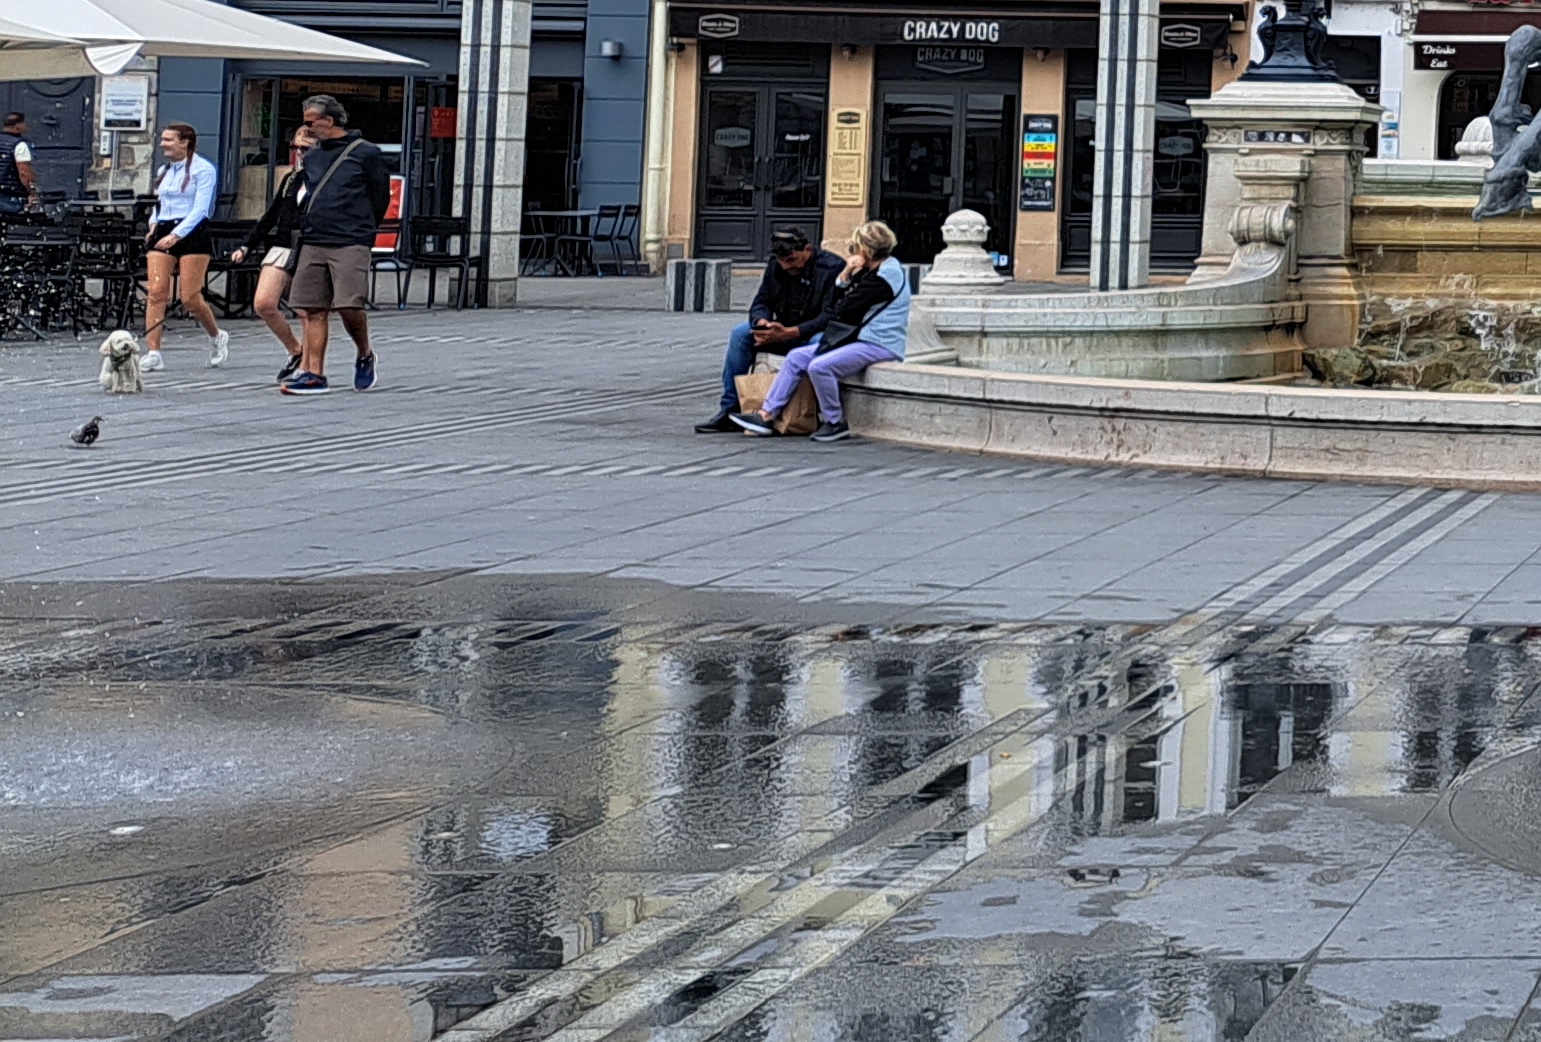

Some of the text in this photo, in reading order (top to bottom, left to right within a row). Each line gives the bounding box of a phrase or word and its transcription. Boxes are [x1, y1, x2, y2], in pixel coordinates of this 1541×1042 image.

[903, 21, 999, 42] CRAZY DOG
[916, 47, 957, 62] CRAZY
[1422, 45, 1455, 55] Drinks
[1430, 59, 1448, 68] Eat
